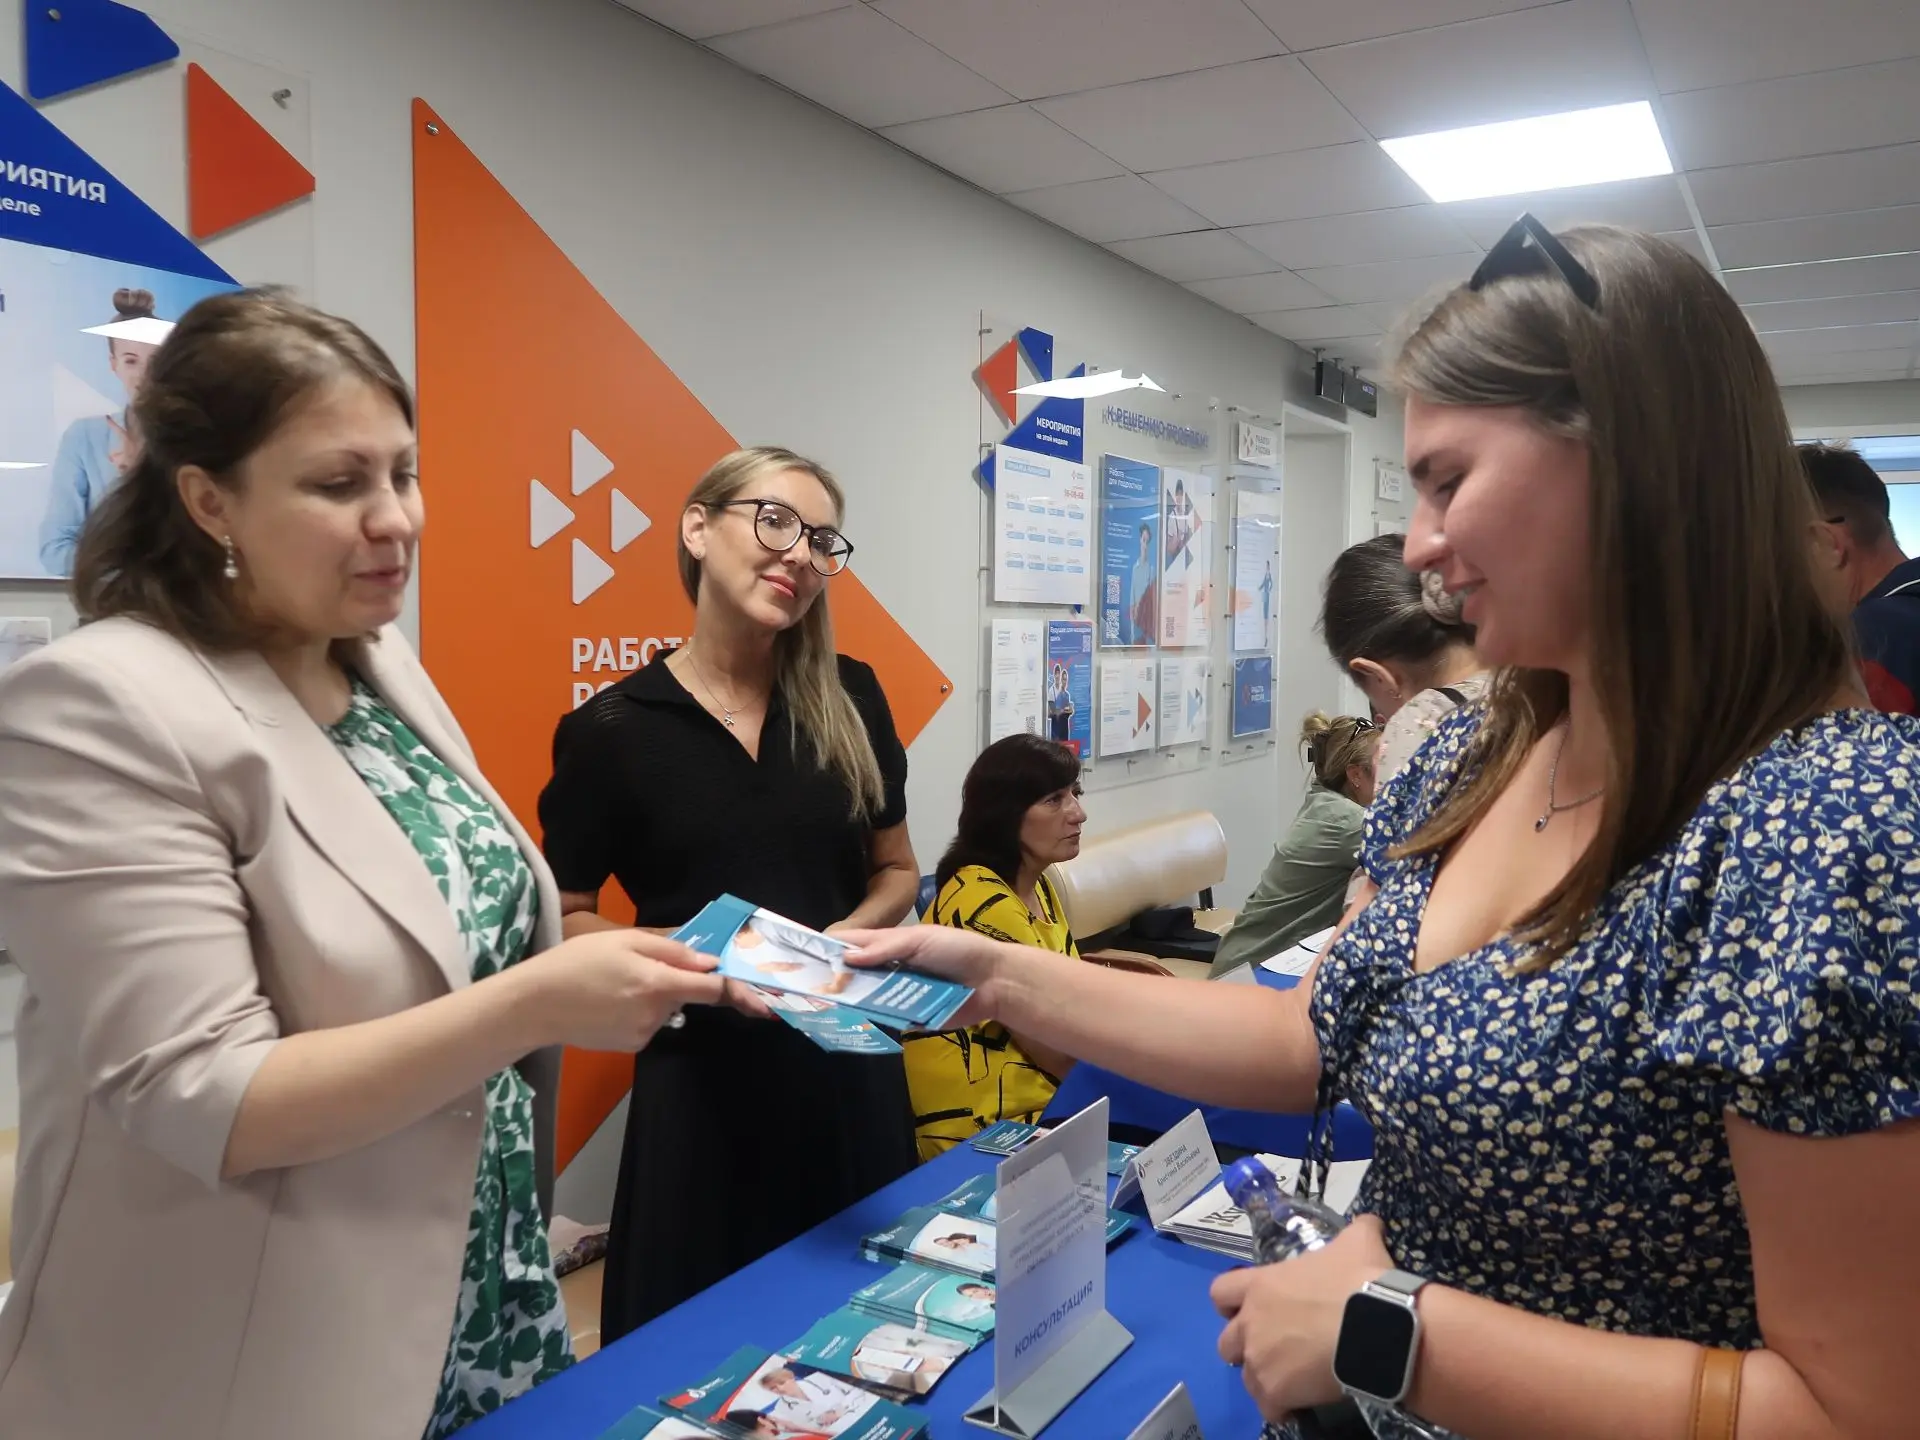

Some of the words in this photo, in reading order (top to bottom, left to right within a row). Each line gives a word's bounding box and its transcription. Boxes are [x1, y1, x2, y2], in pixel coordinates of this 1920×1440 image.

[1036, 416, 1081, 437] МЕРОПРИЯТИЯ
[572, 637, 691, 673] РАБОТ
[1014, 1280, 1093, 1358] КОНСУЛЬТАЦИЯ
